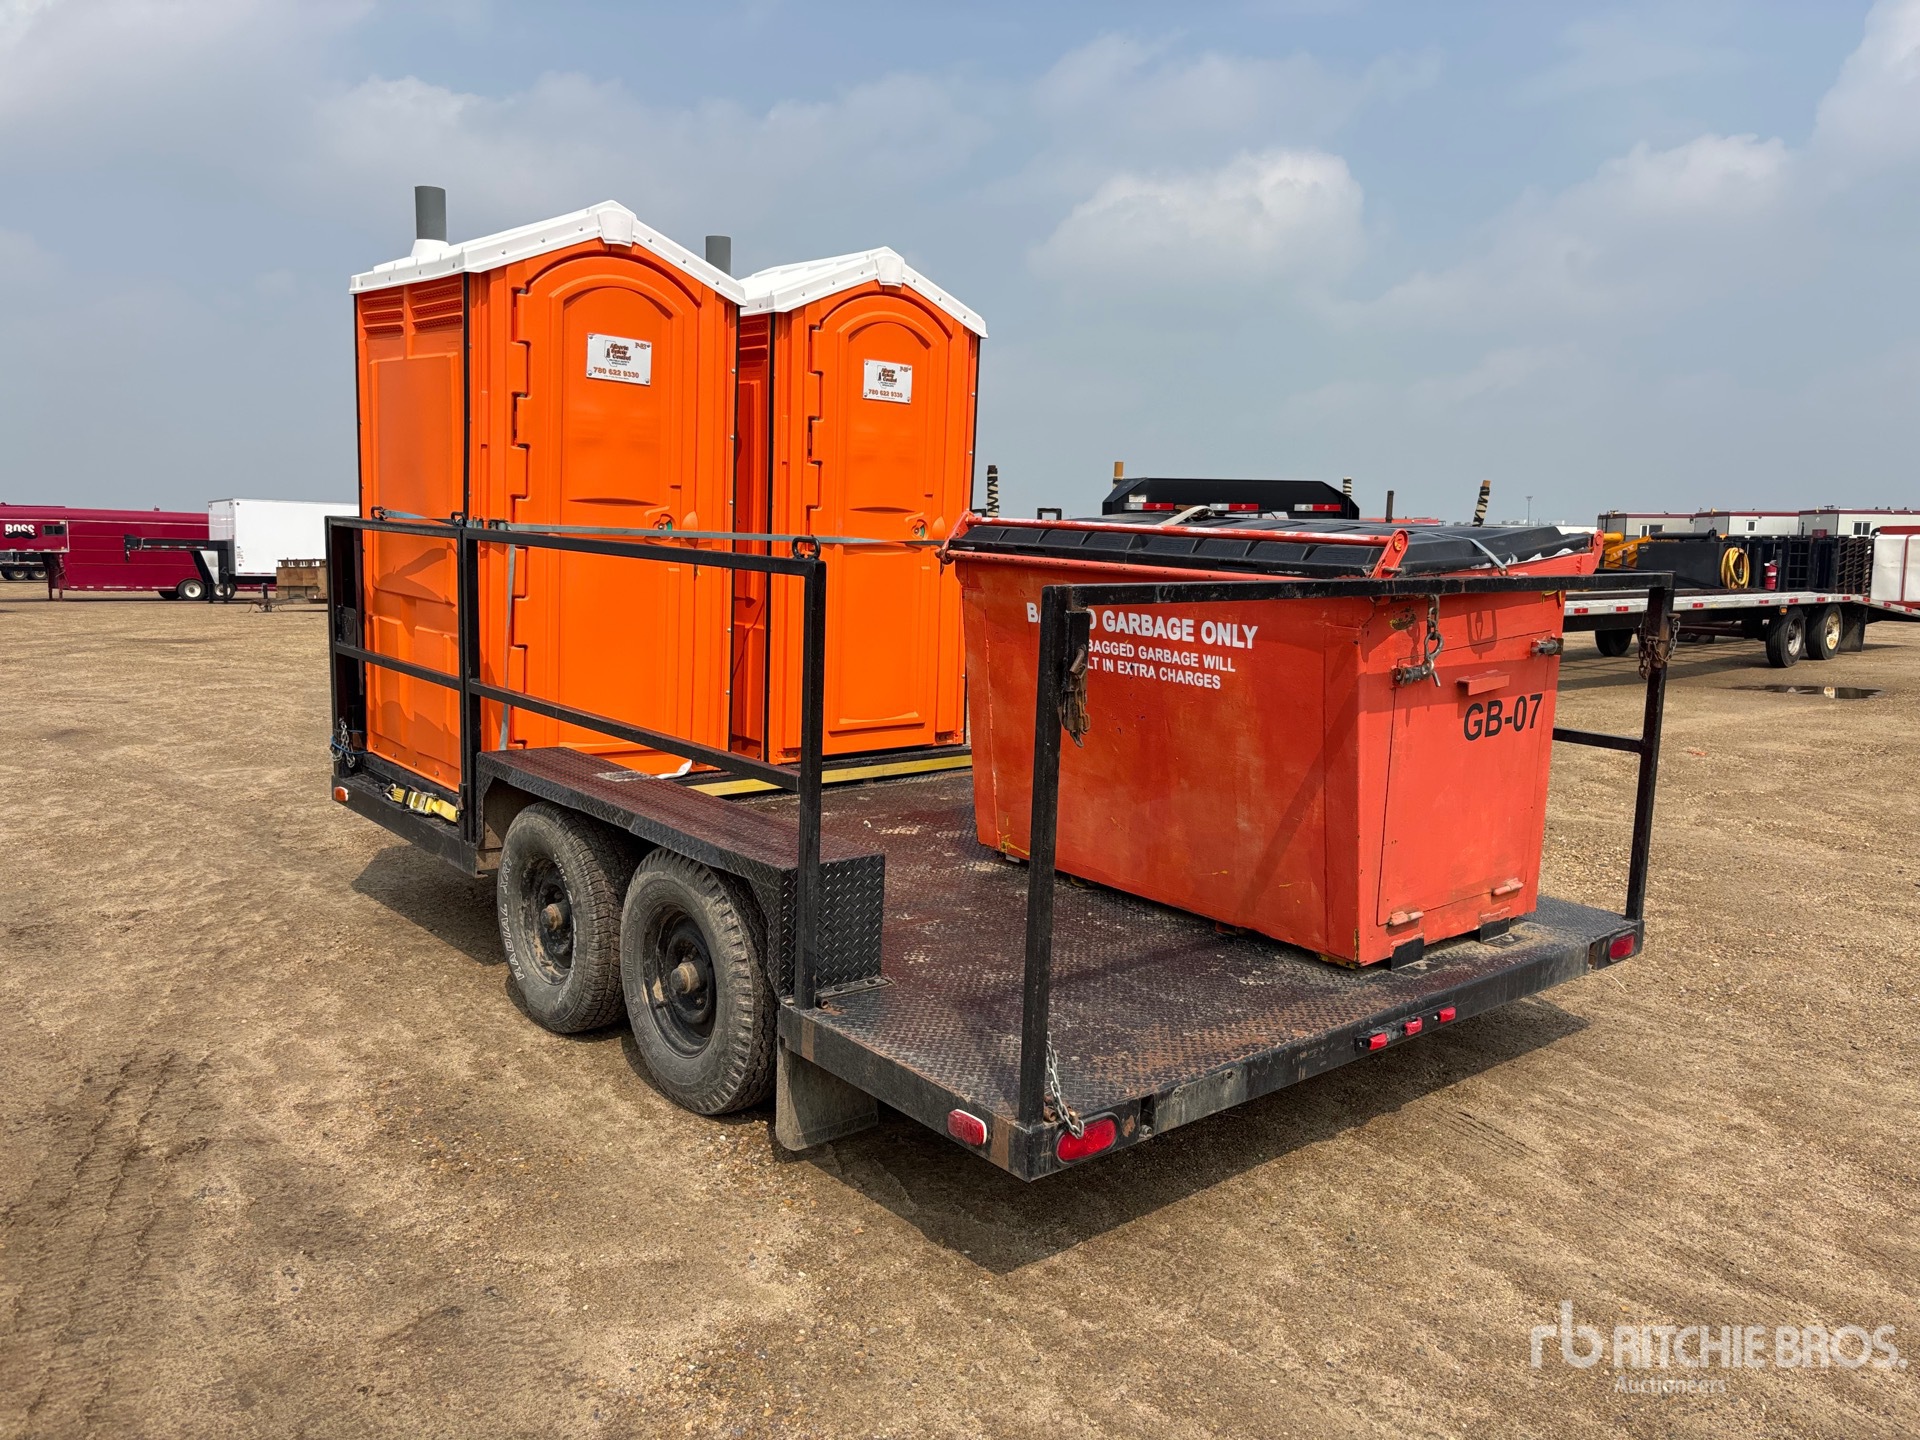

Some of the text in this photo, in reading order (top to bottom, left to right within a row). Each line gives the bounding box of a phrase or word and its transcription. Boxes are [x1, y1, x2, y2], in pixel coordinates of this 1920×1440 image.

[1102, 610, 1195, 642] GARBAGE
[1201, 621, 1259, 649] ONLY
[1103, 659, 1114, 672] IN
[1117, 661, 1156, 679] EXTRA
[1159, 668, 1221, 689] CHARGES
[1138, 647, 1199, 667] GARBAGE
[1203, 654, 1236, 672] WILL
[1464, 693, 1543, 741] GB-07
[500, 903, 525, 981] RADIAL
